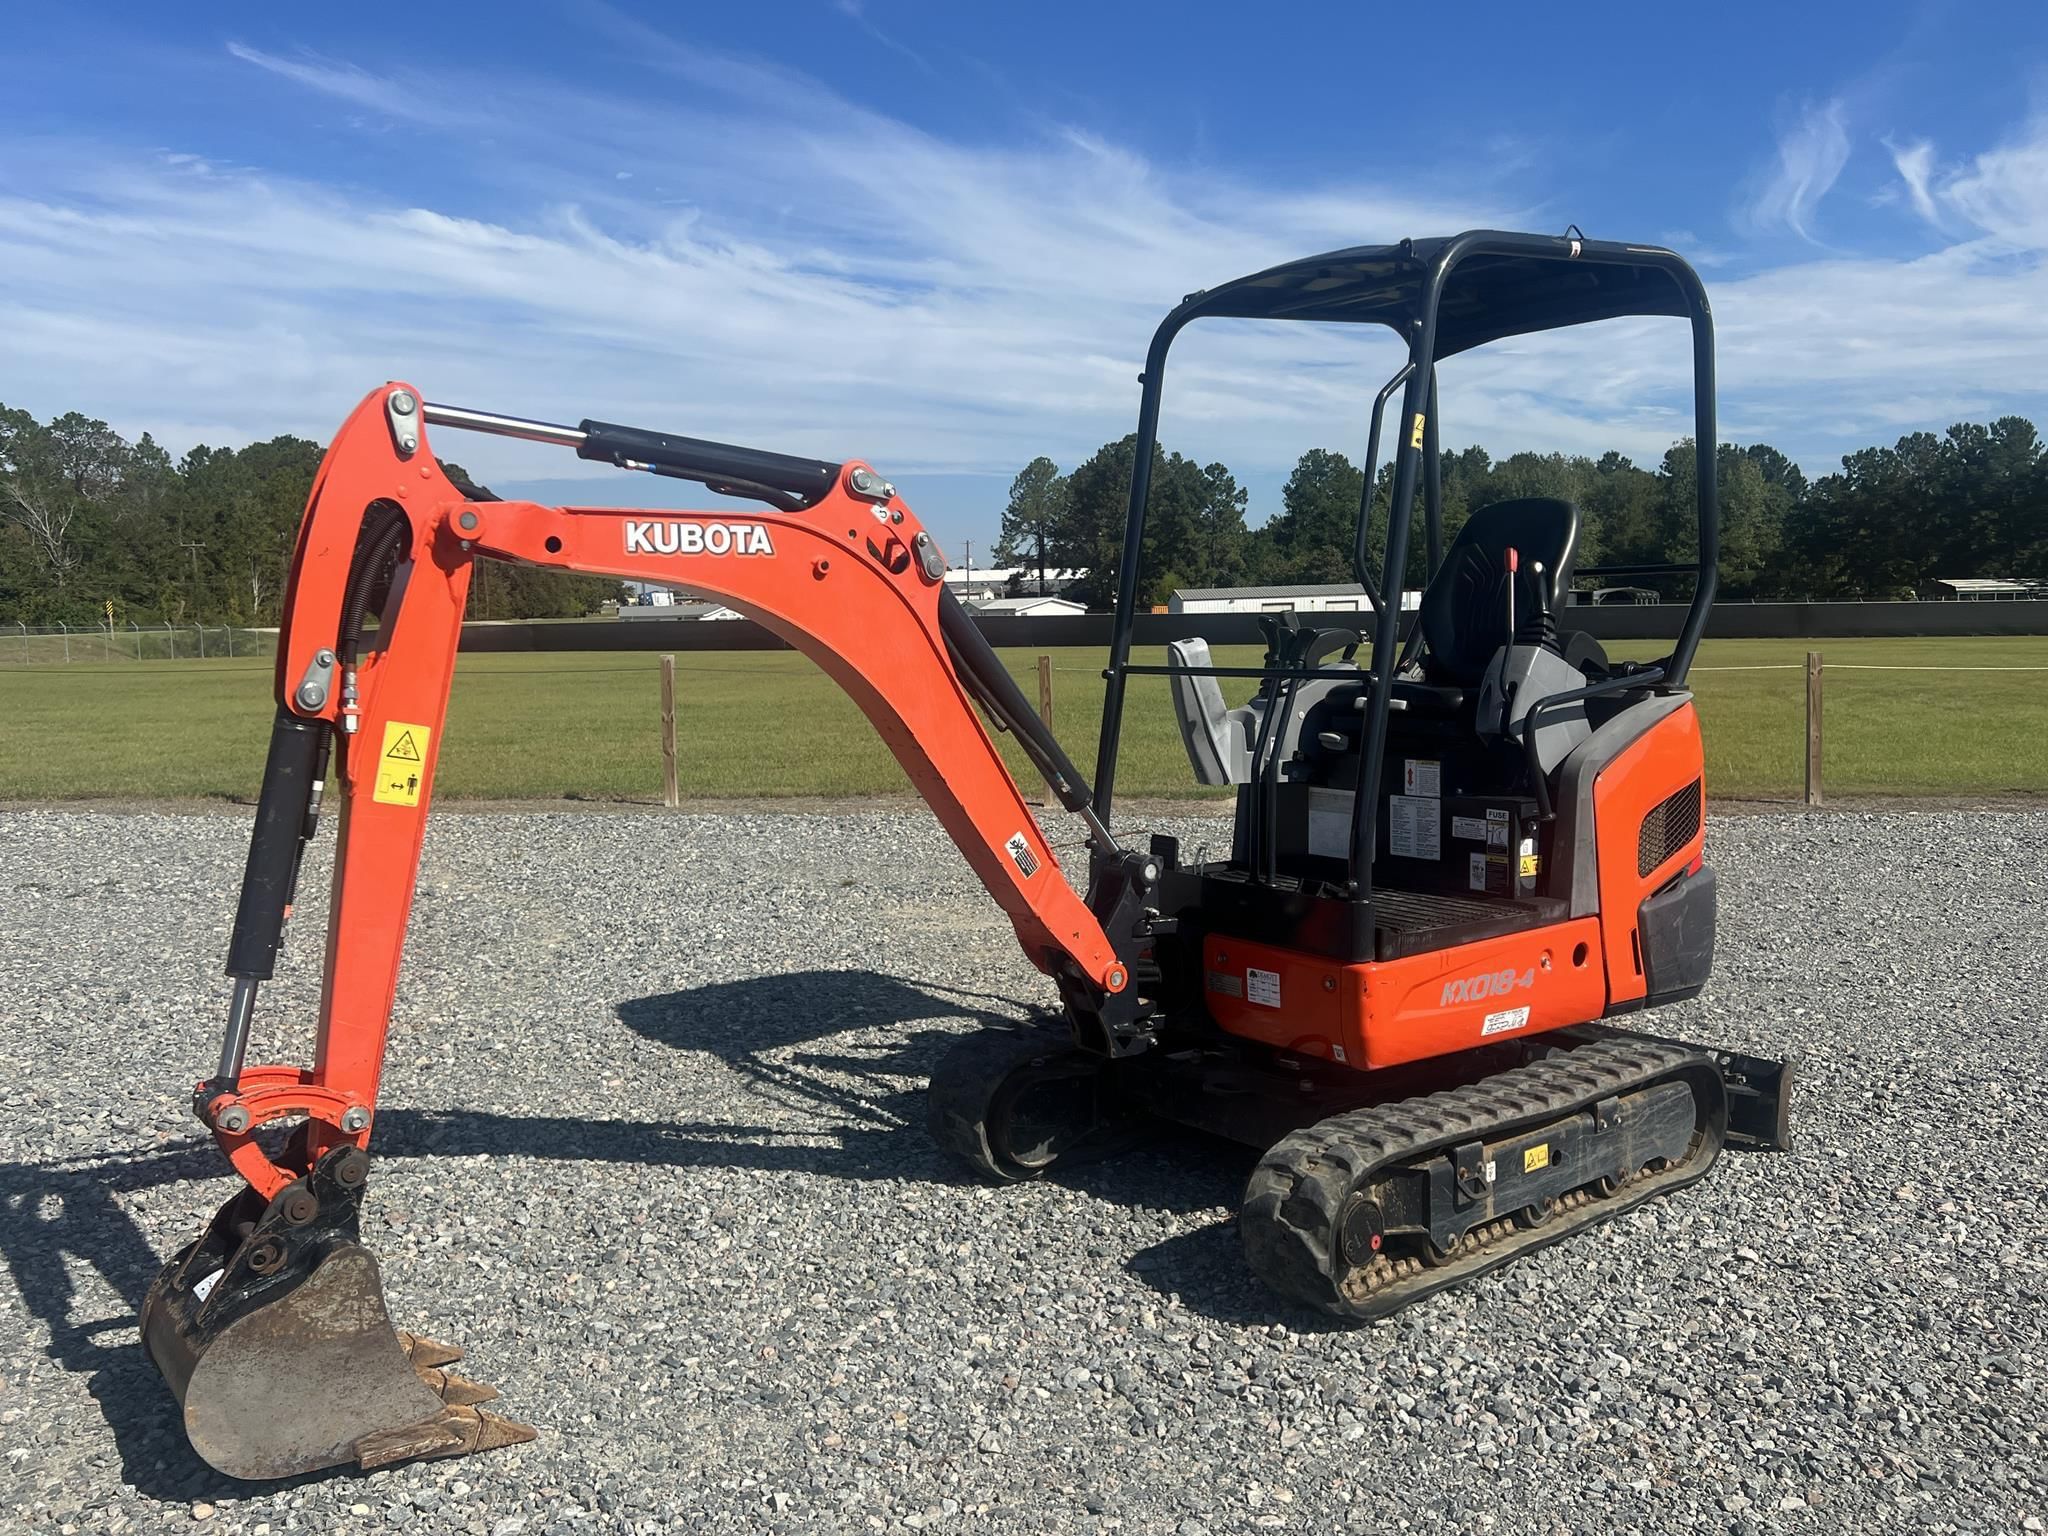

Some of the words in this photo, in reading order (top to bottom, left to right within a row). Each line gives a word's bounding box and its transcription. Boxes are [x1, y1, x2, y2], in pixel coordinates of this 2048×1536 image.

[626, 522, 773, 554] KUBOTA
[1488, 811, 1507, 820] FUSE
[1440, 968, 1534, 1007] KX018-4
